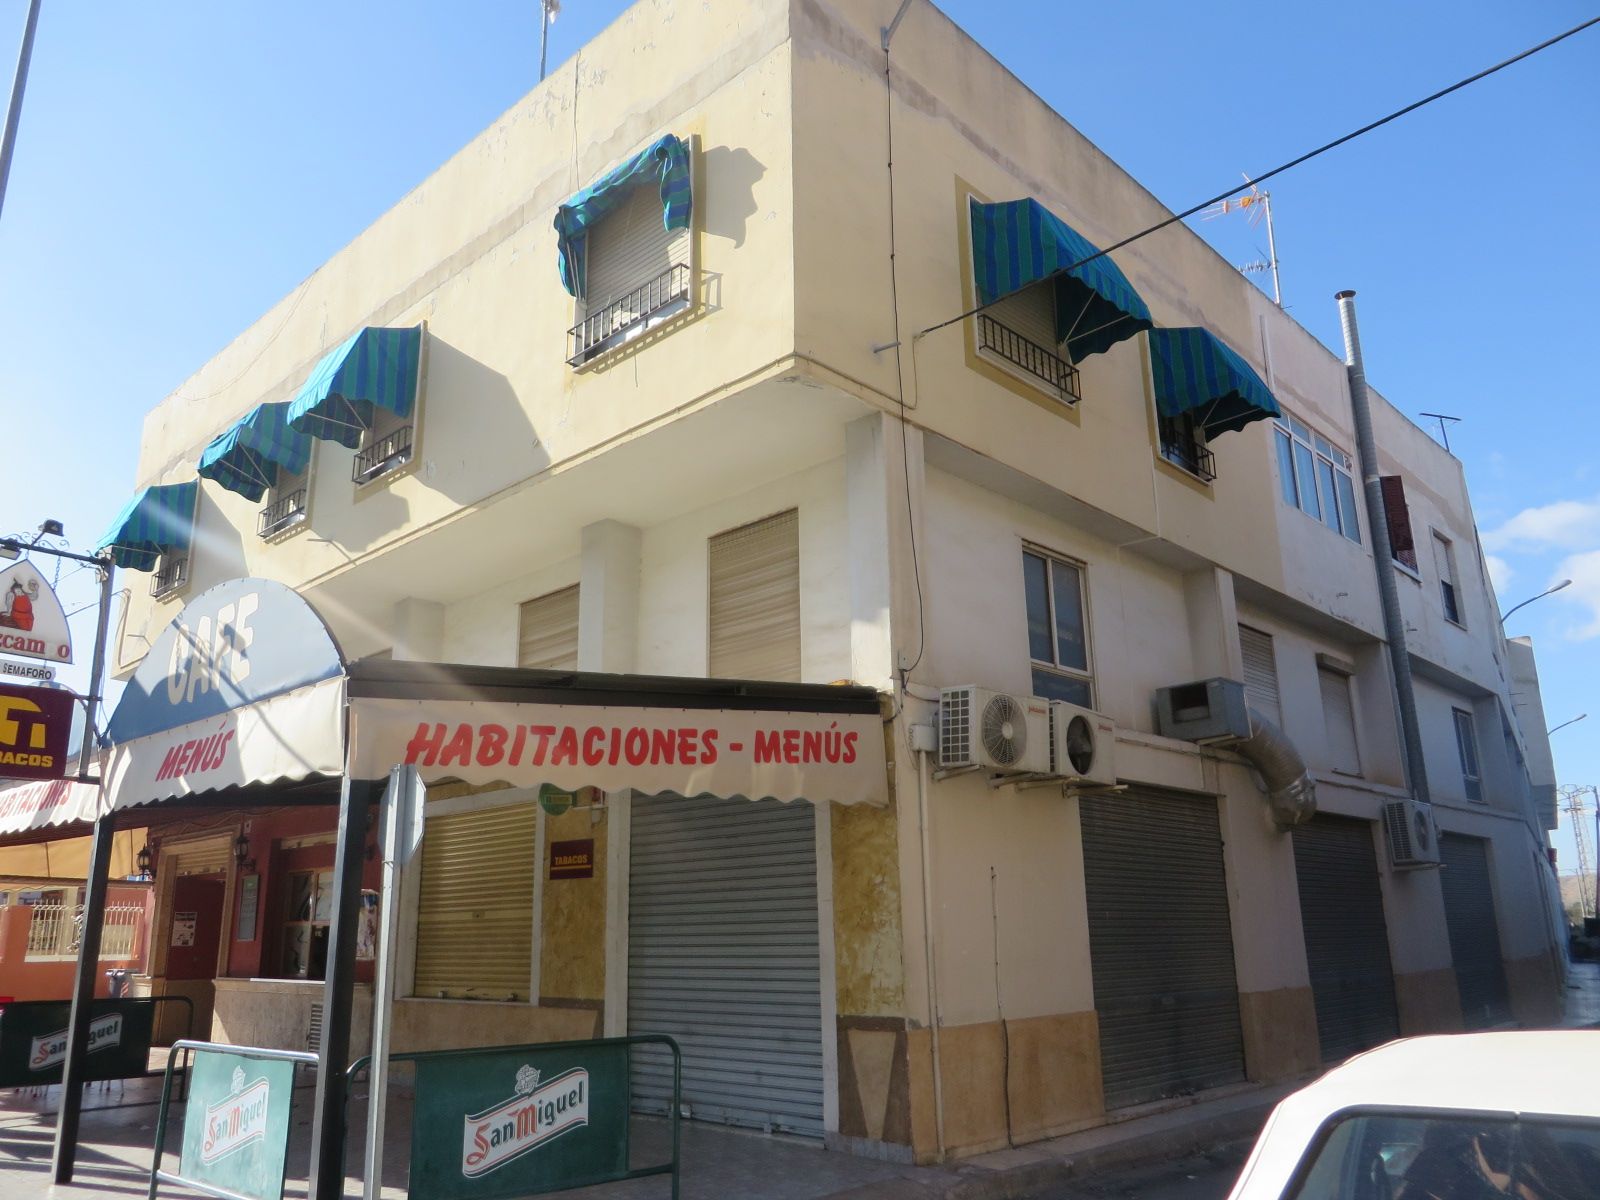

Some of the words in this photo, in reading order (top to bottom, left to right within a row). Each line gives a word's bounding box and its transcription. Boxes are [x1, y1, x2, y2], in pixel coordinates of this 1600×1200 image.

[168, 592, 259, 705] CAFE
[3, 663, 52, 680] SEMAFORO
[0, 751, 53, 768] ACOS
[155, 720, 235, 782] MENÚS
[404, 722, 718, 767] HABITACIONES
[754, 721, 858, 764] MENÚS
[554, 854, 588, 866] TABACOS
